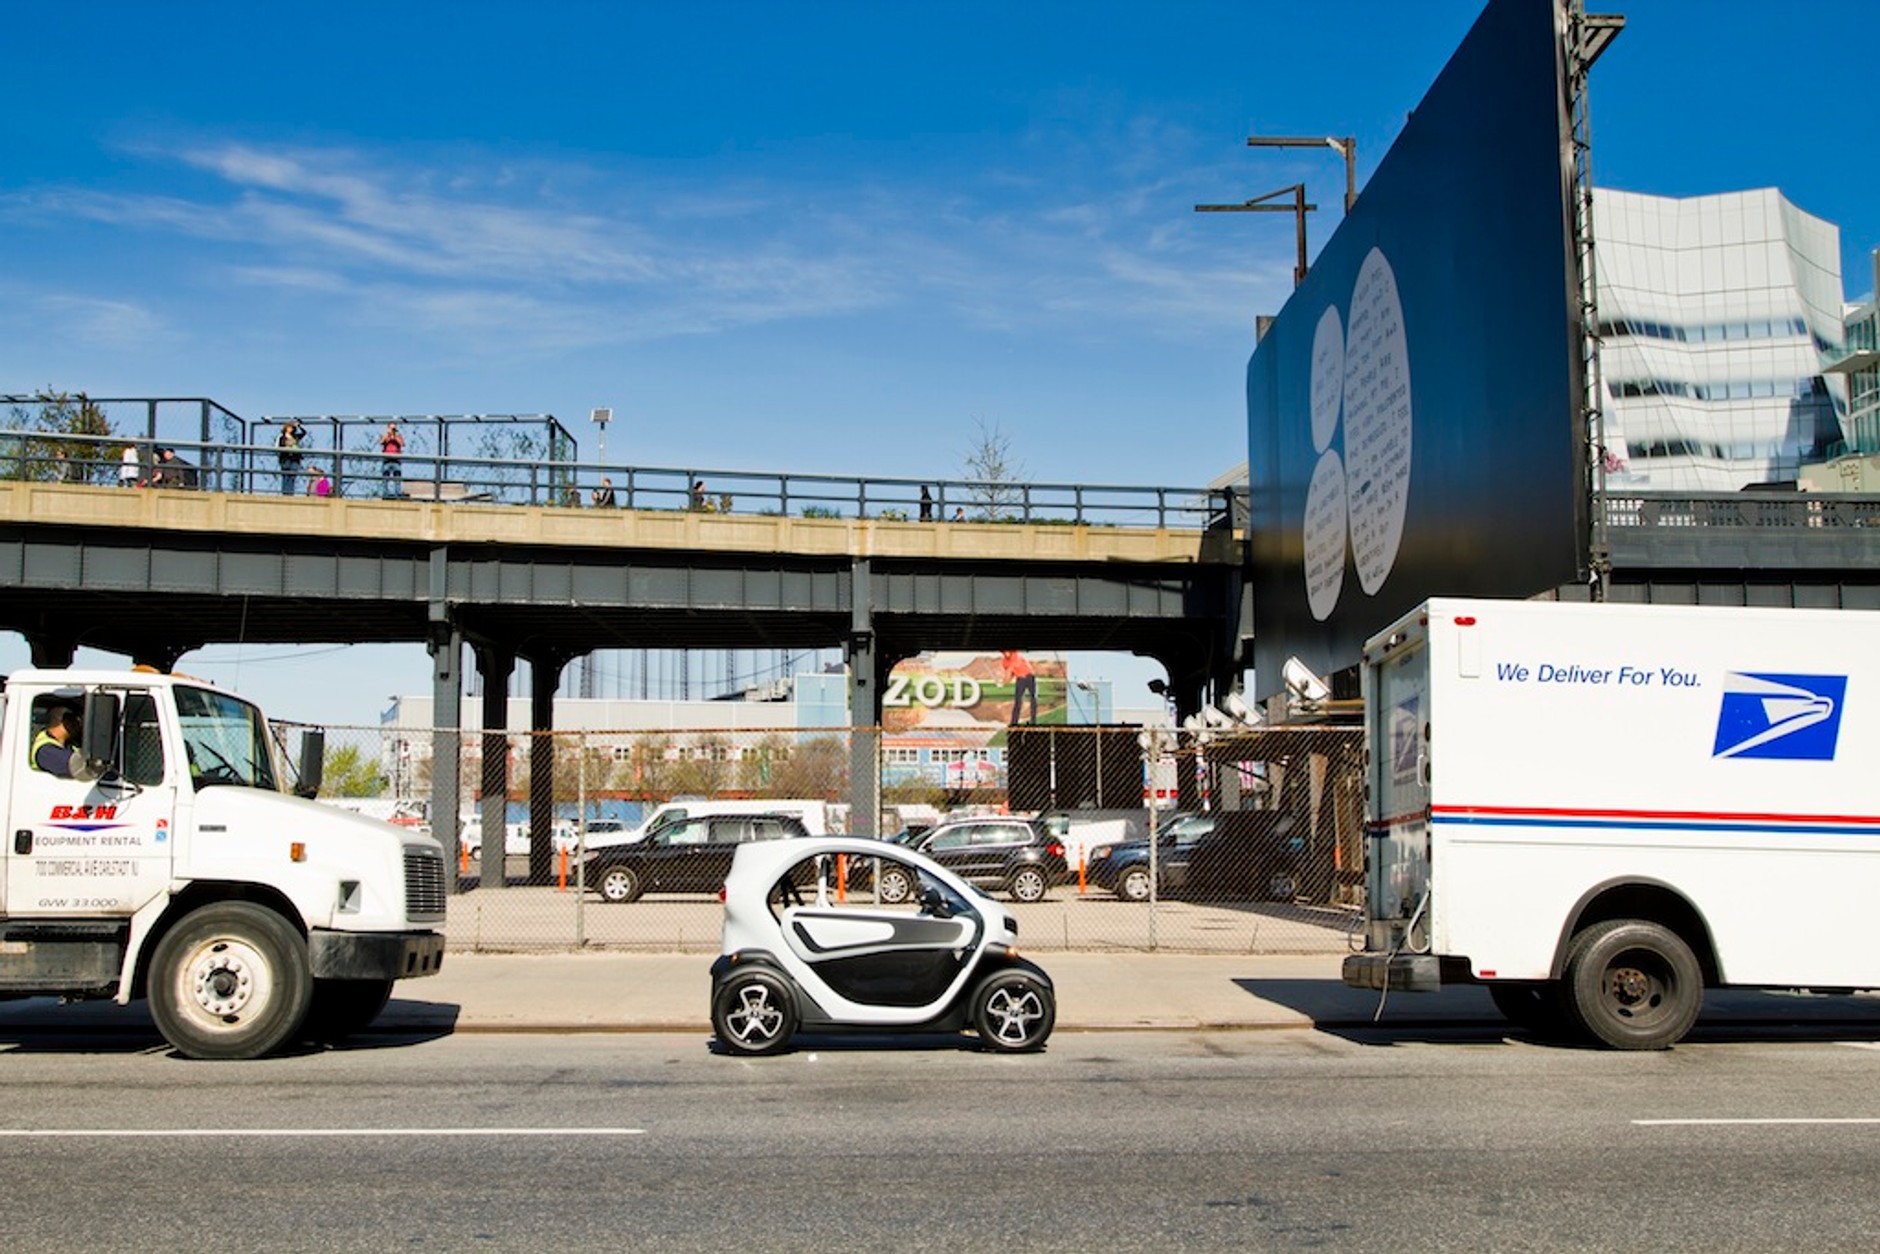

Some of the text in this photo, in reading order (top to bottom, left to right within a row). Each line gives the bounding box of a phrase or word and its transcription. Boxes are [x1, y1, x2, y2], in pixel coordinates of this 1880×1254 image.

[1497, 663, 1702, 688] We Deliver For You.
[34, 836, 143, 847] EQUIPMENT RENTAL
[38, 897, 68, 908] GVW
